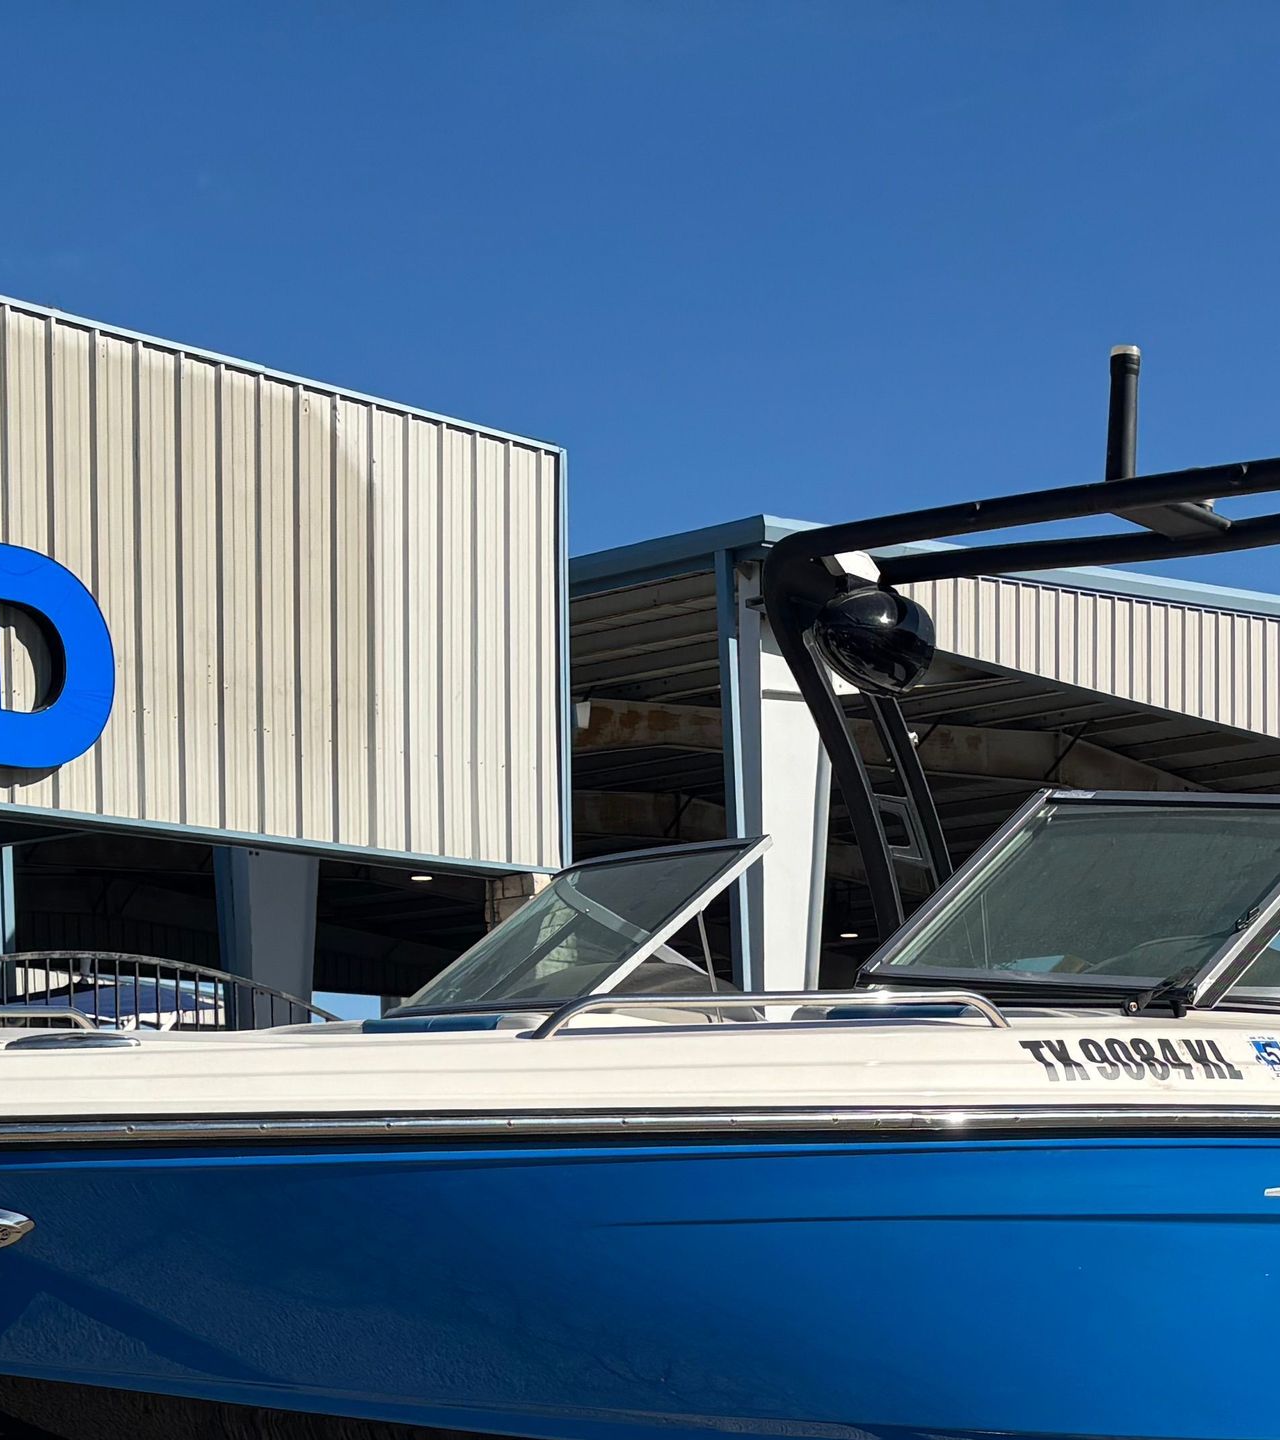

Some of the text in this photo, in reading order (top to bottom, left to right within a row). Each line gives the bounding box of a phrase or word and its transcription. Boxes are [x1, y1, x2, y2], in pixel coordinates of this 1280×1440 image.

[1019, 1037, 1244, 1082] TX 9084 KL
